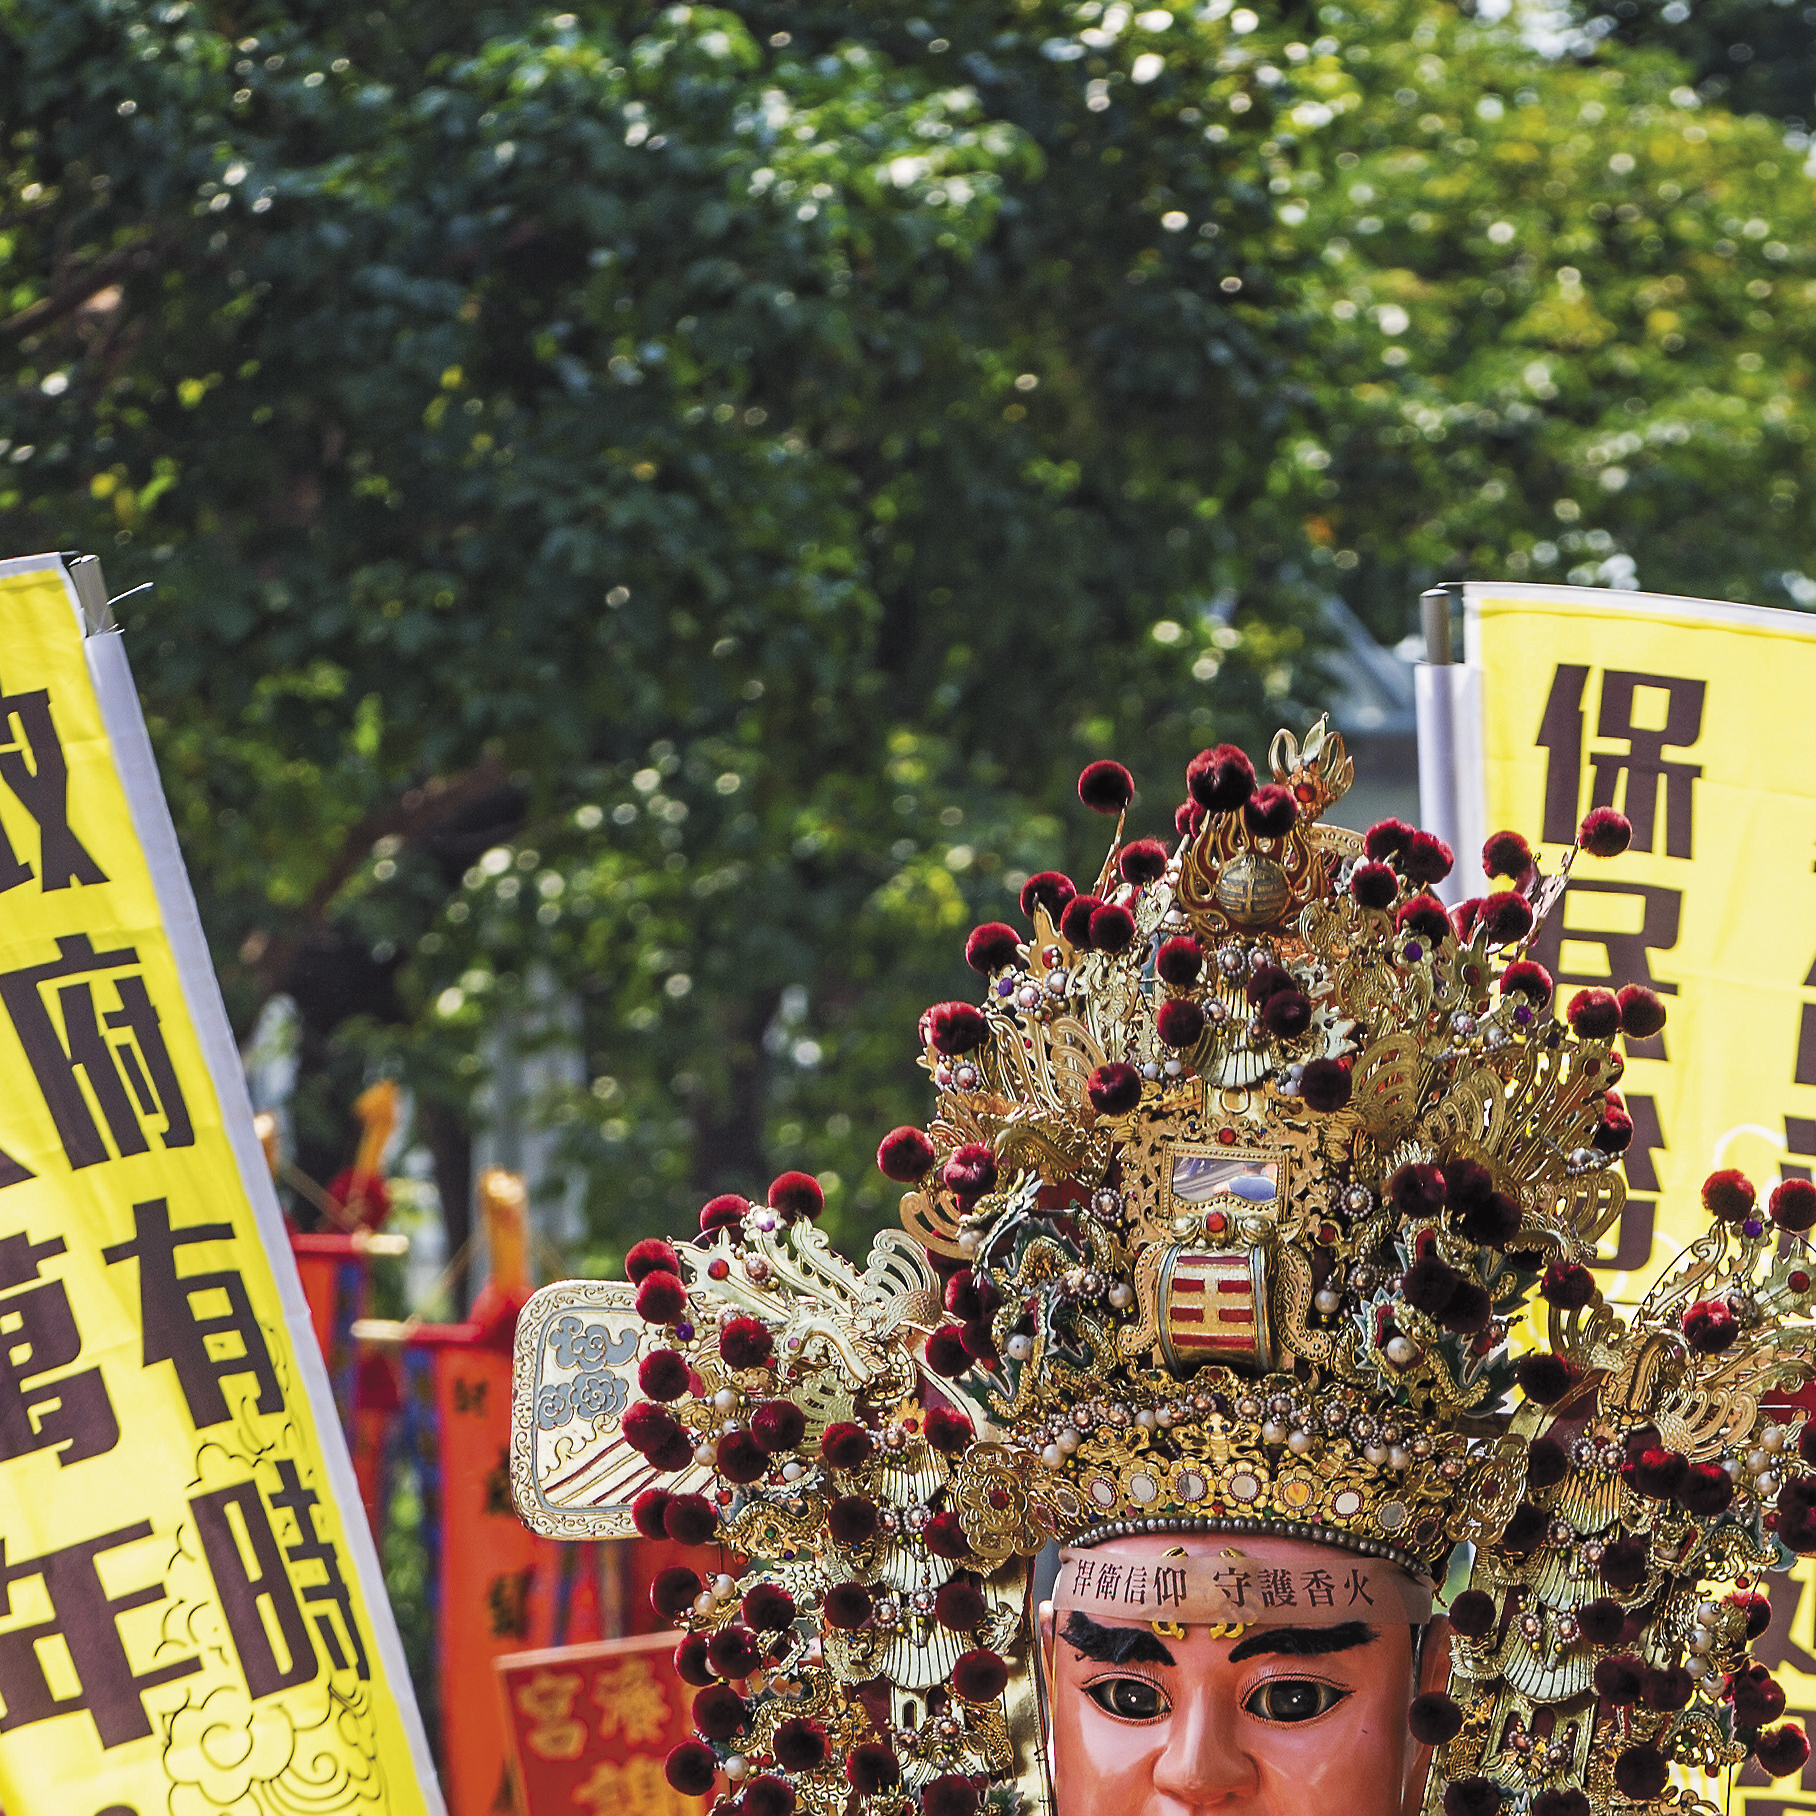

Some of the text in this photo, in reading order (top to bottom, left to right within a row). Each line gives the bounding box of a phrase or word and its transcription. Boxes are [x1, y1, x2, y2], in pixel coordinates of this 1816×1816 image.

[1072, 1558, 1375, 1609] 捍衛信仰 守護香火
